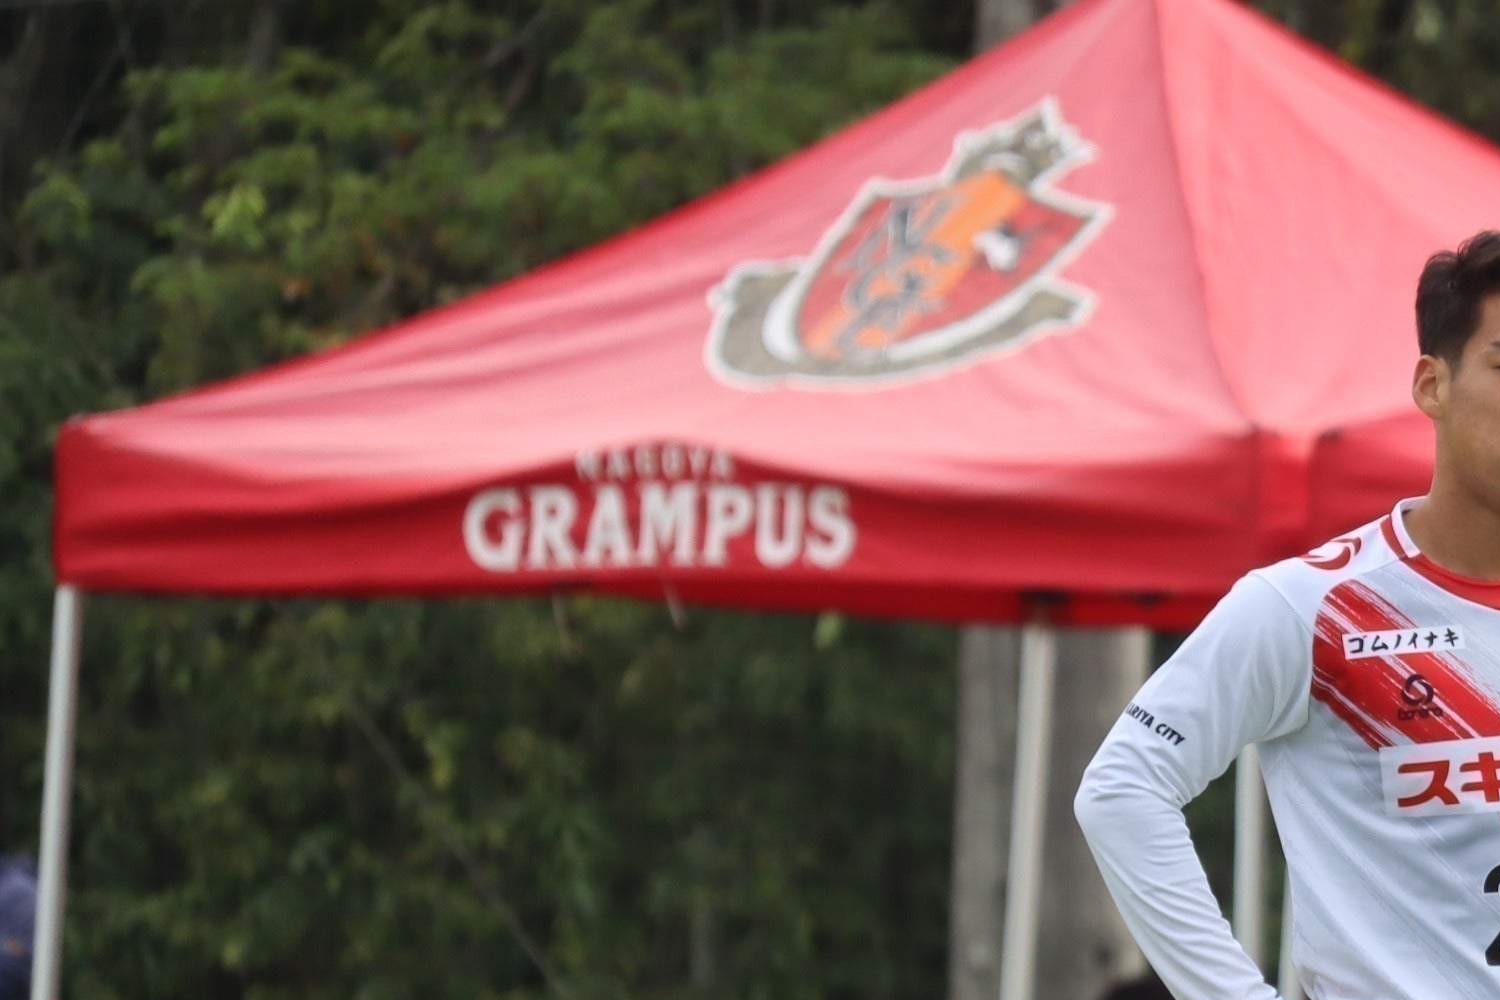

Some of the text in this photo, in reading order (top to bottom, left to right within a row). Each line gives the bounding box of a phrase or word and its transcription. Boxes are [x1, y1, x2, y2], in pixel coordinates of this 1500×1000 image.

[462, 480, 858, 572] GRAMPUS
[1347, 627, 1460, 655] ゴムノイナキ
[1154, 722, 1186, 747] CITY
